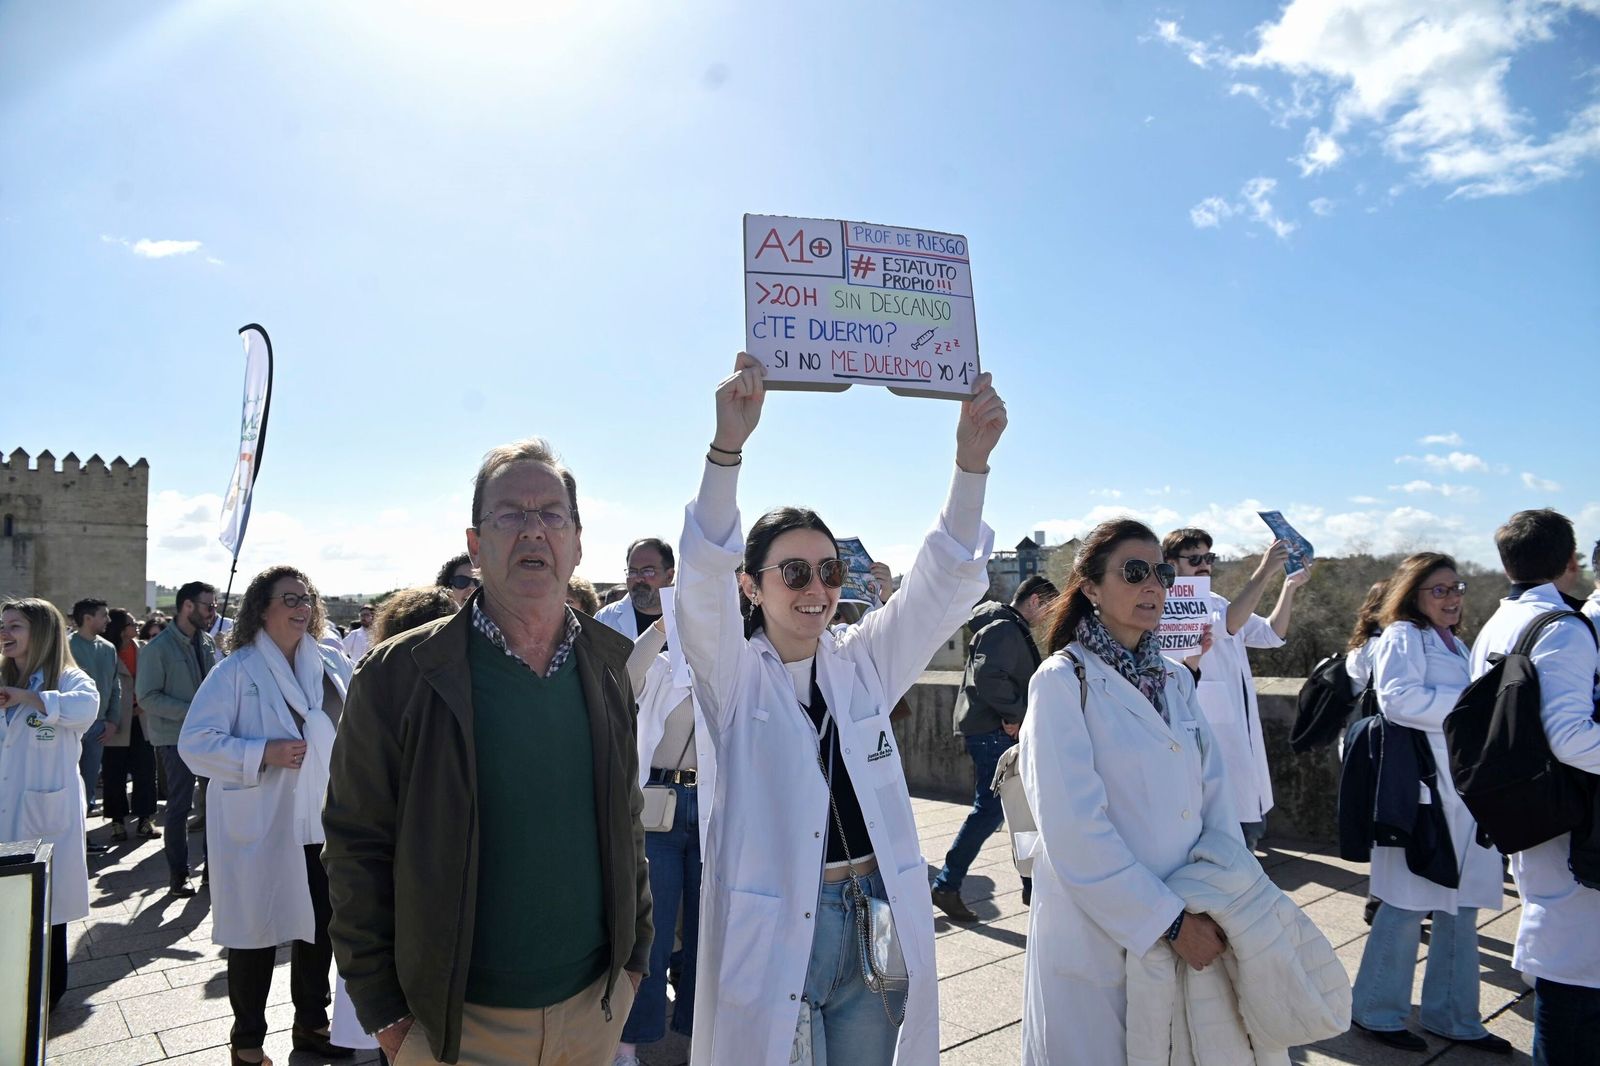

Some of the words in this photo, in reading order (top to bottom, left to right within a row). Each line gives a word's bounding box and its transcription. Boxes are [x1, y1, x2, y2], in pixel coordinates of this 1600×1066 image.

[897, 236, 912, 248] DE
[917, 233, 966, 256] RIESGO
[883, 256, 957, 281] ESTATUTO
[883, 273, 952, 295] PROPIO!!!
[834, 290, 862, 310] SIN
[870, 292, 951, 321] DESCANSO
[753, 311, 796, 340] ¿TE
[809, 318, 898, 348] DUERMO?
[799, 352, 822, 371] NO
[831, 349, 858, 373] ME
[864, 353, 932, 378] DUERMO
[937, 362, 954, 382] YO
[1168, 584, 1194, 598] PIDEN
[1162, 601, 1208, 615] ELENCIA
